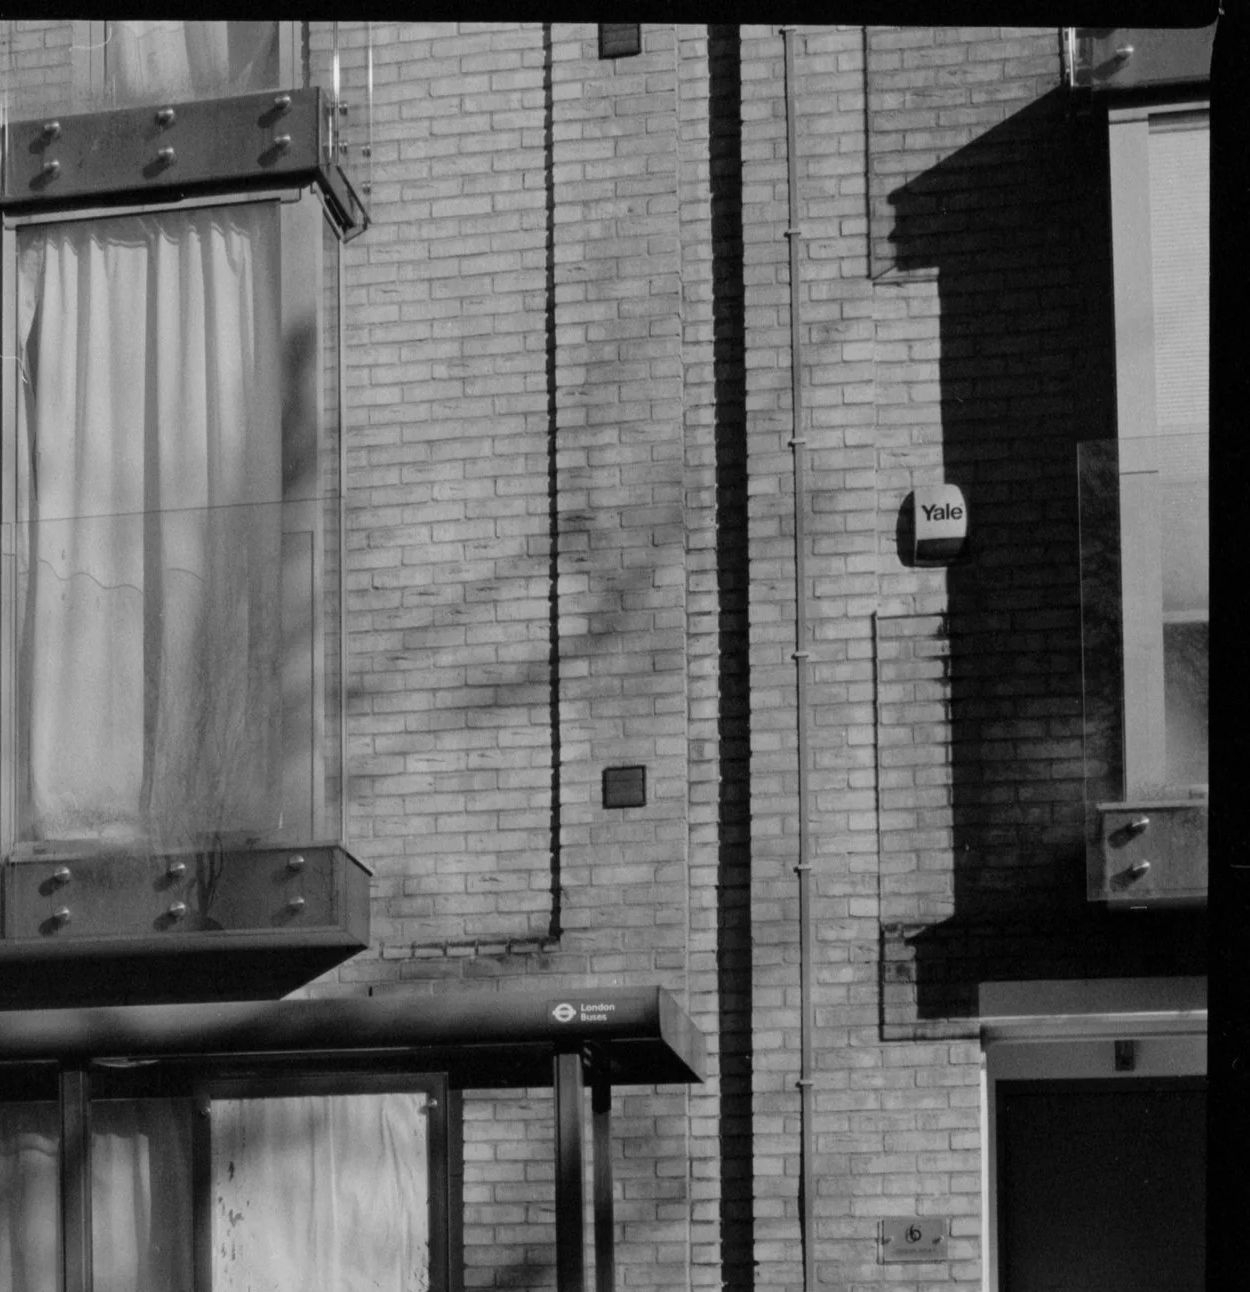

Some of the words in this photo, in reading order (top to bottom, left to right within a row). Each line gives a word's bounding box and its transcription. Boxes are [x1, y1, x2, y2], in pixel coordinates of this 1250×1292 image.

[921, 503, 963, 521] Yale
[580, 1003, 615, 1012] London
[580, 1013, 607, 1021] Buses
